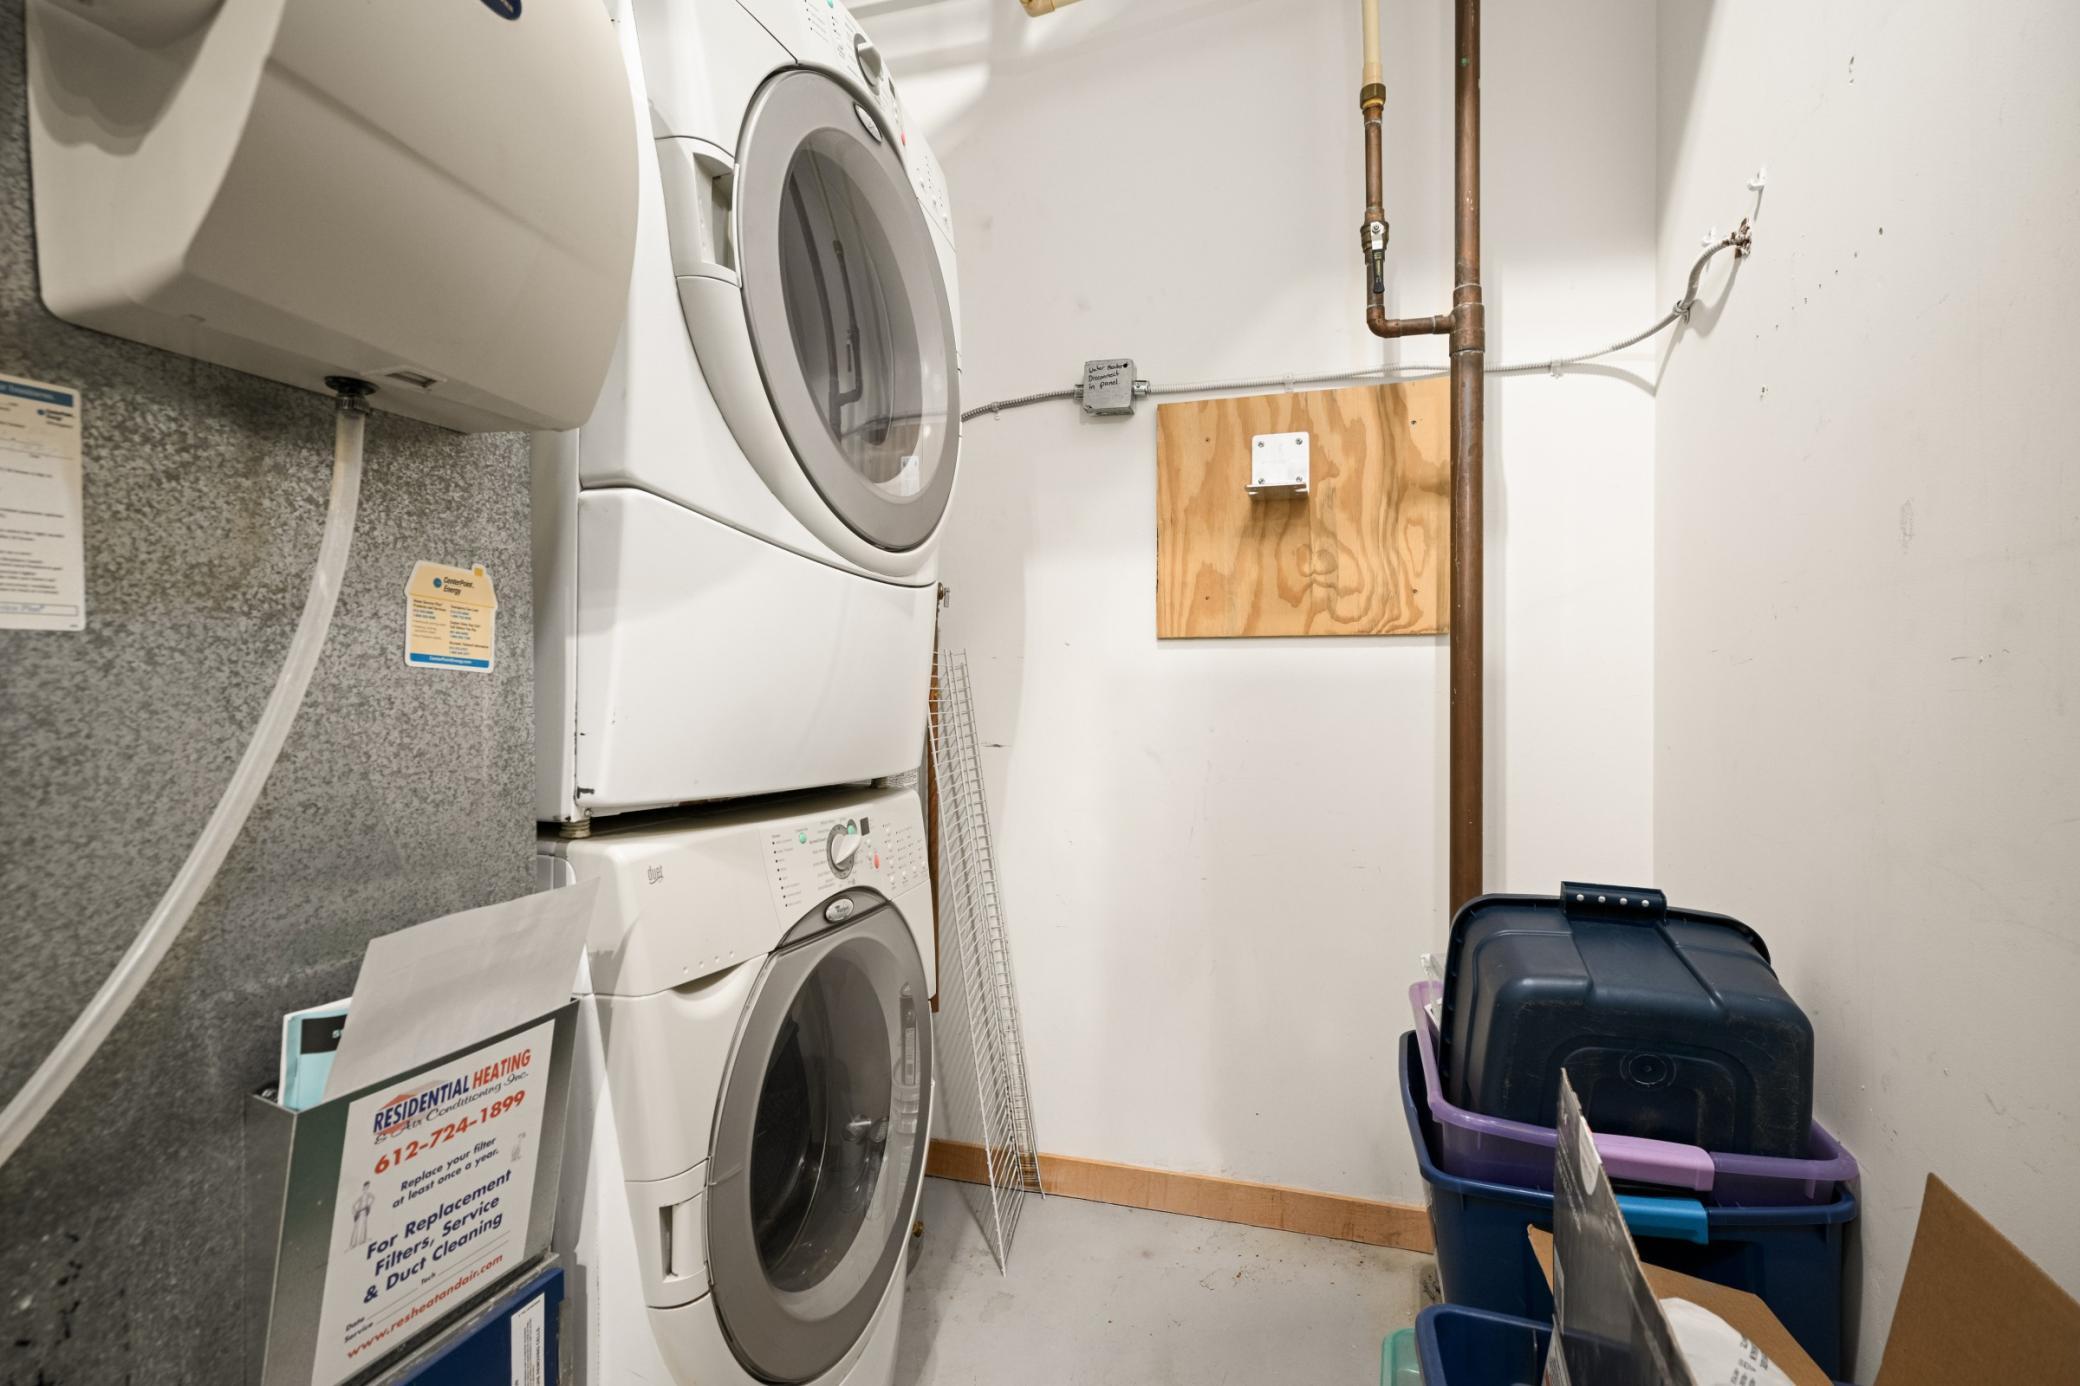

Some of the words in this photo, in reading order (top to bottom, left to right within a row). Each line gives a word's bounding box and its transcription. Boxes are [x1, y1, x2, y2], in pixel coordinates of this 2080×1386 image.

[443, 584, 462, 596] Energy
[373, 1075, 470, 1134] RESIDENTIAL
[472, 1049, 532, 1090] HEATING
[374, 1090, 526, 1175] 612-724-1899
[426, 1083, 502, 1122] Conditioning
[503, 1071, 529, 1086] Inc.
[392, 1196, 405, 1209] at
[407, 1180, 434, 1201] least
[437, 1168, 462, 1185] once
[465, 1162, 472, 1170] a
[475, 1149, 499, 1168] year.
[400, 1165, 443, 1191] Replace
[447, 1151, 471, 1170] your
[473, 1138, 496, 1154] filter
[366, 1234, 398, 1261] For
[404, 1168, 512, 1238] Replacement
[375, 1236, 435, 1277] Filters,
[441, 1196, 500, 1237] Service
[363, 1284, 379, 1304] &
[386, 1257, 426, 1291] Duct
[432, 1213, 503, 1261] Cleaning
[347, 1254, 503, 1359] www.resheatandair.com
